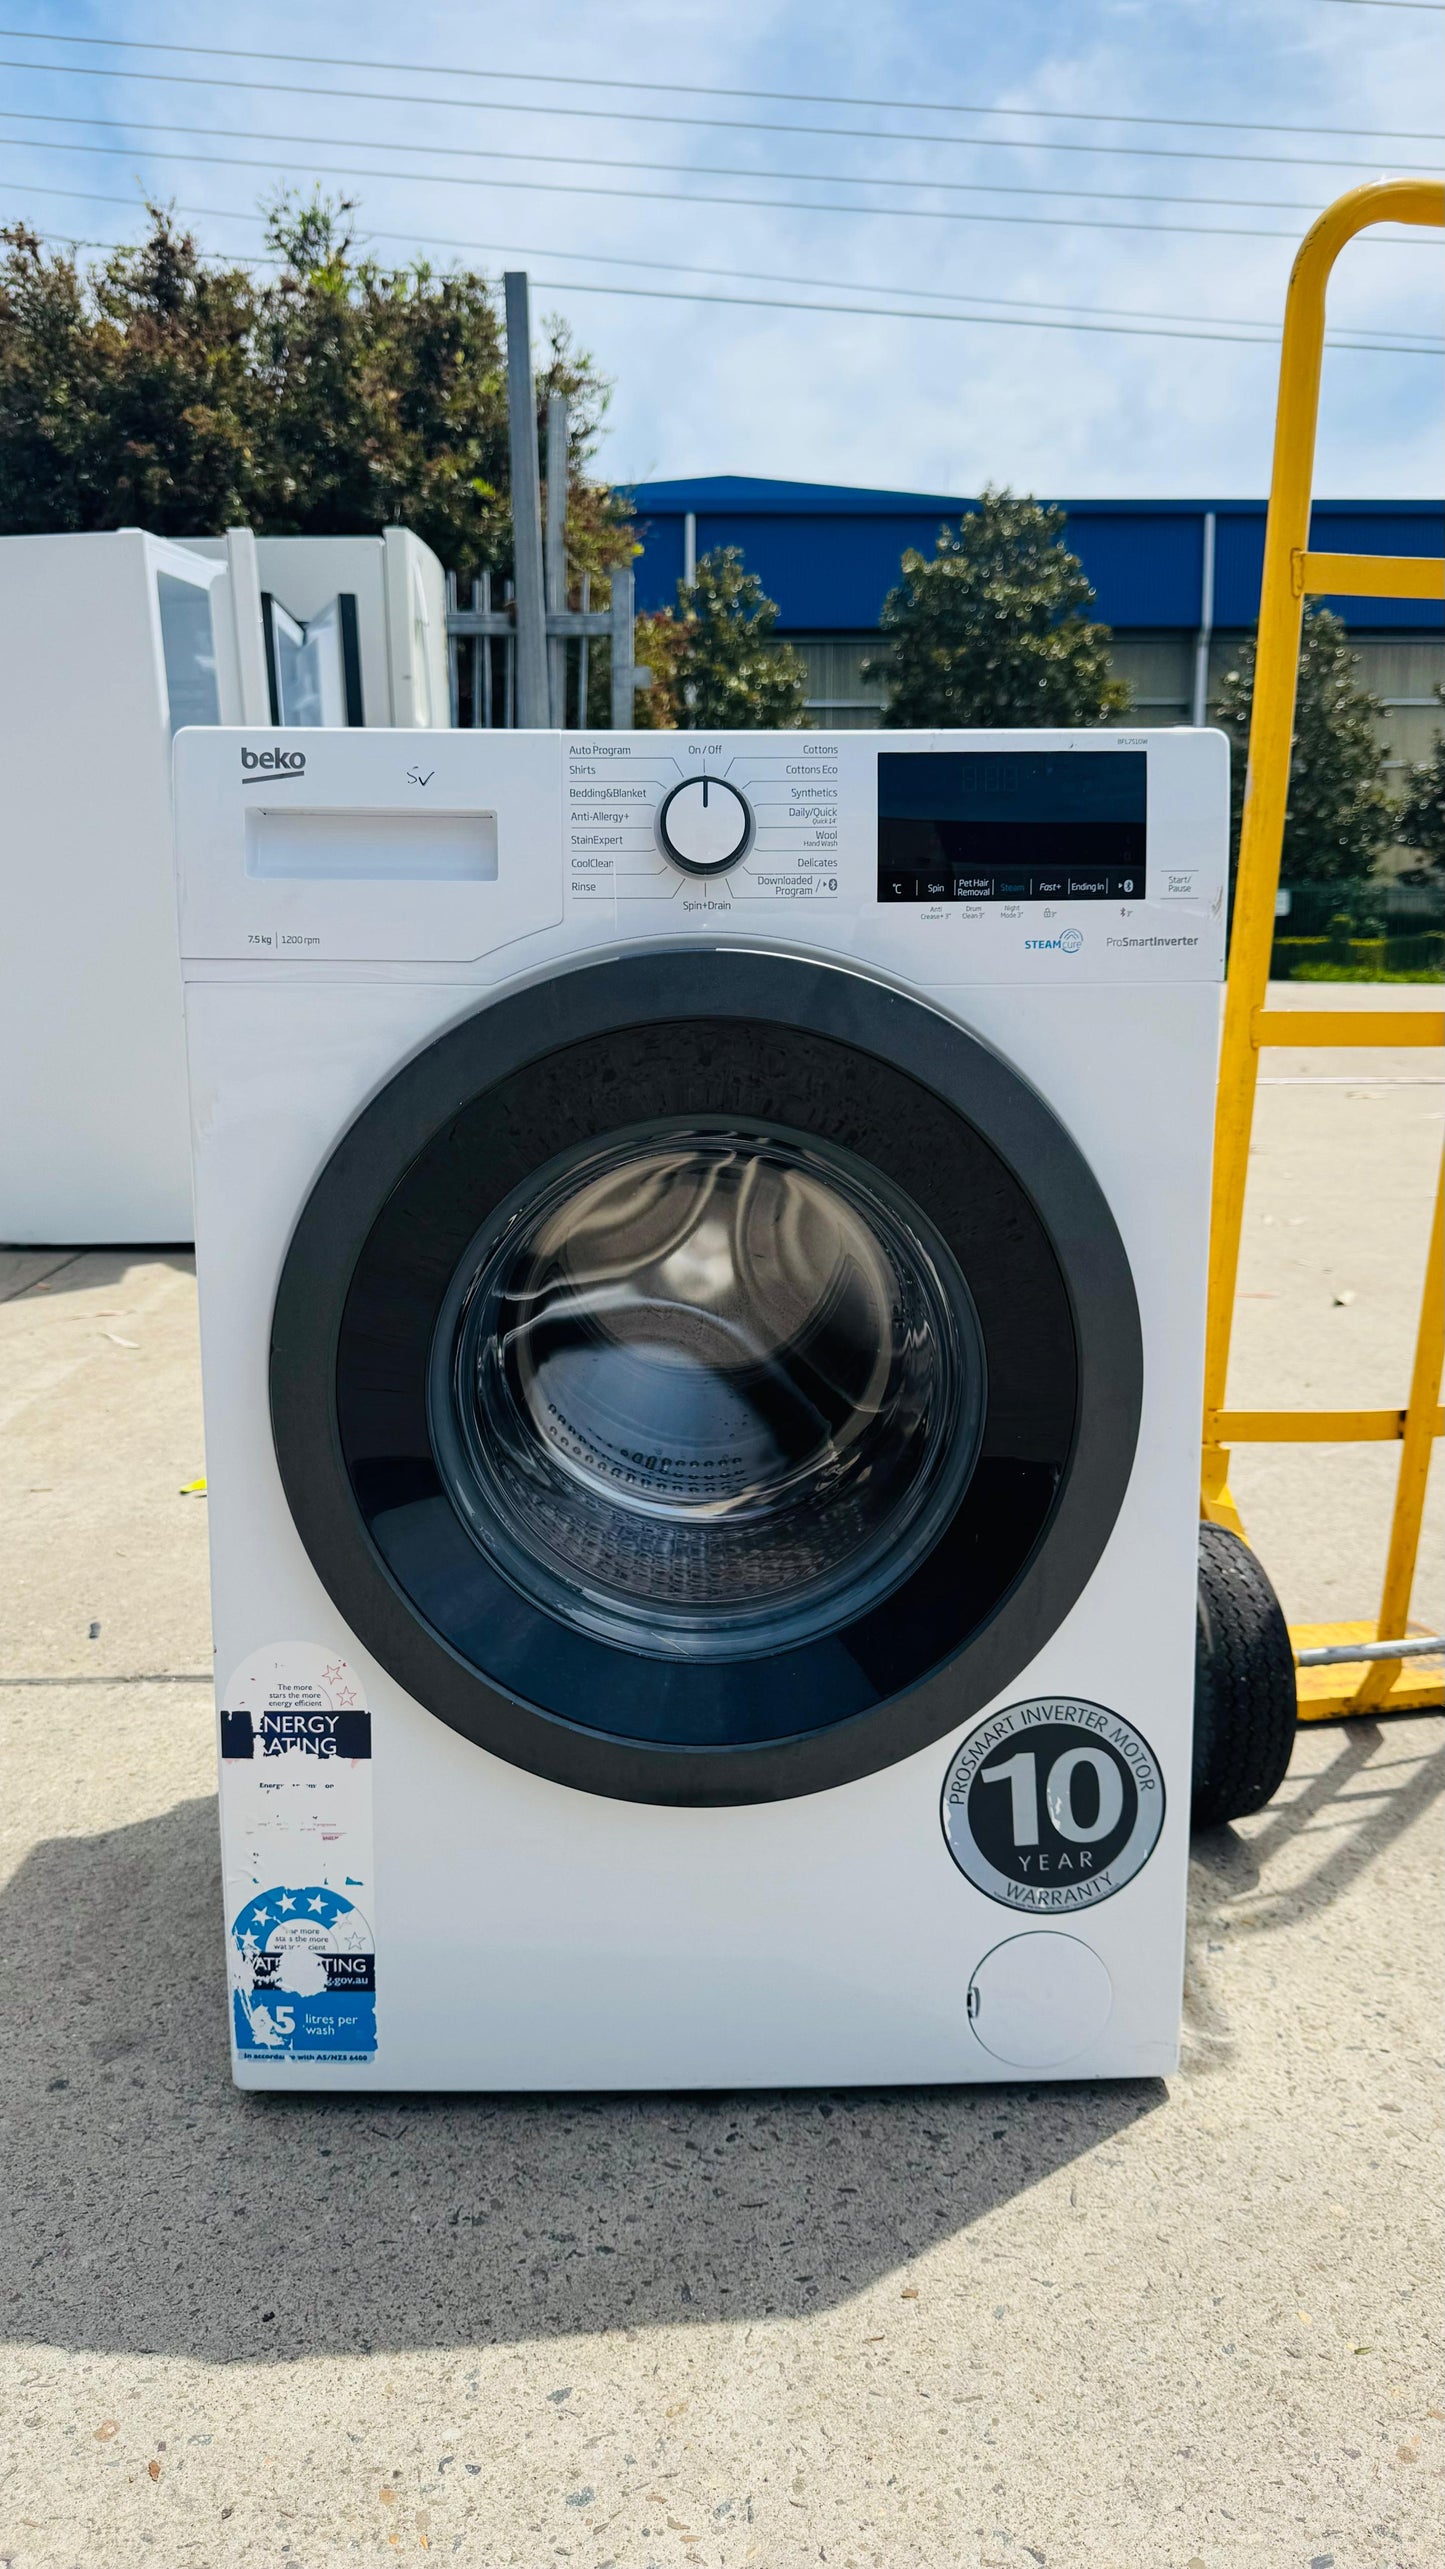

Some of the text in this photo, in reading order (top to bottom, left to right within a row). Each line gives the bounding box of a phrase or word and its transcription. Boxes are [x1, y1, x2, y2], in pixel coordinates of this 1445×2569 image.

[569, 746, 631, 757] Auto Program
[688, 746, 701, 754] On
[708, 745, 722, 754] Off
[803, 745, 839, 754] Cottons
[241, 747, 306, 769] beko
[569, 766, 596, 774] Shirts
[786, 765, 838, 774] Cottons Eco
[569, 789, 647, 800] Bedding&Blanket
[791, 788, 838, 799] Synthetics
[571, 812, 630, 823] Anti-Allergy+
[789, 808, 838, 818] Daily/Quick
[816, 831, 838, 840] Wool
[571, 836, 623, 846] StainExpert
[797, 858, 838, 868] Delicates
[757, 876, 813, 885] Downloaded
[958, 879, 989, 887] Pet Hair
[1168, 876, 1191, 884] Start/
[572, 882, 596, 891] Rinse
[775, 886, 813, 896] Program
[928, 884, 944, 894] Spin
[1001, 884, 1025, 892] Steam
[1039, 883, 1062, 892] Fast+
[1071, 882, 1105, 893] Ending In
[958, 888, 990, 897] Removal
[683, 901, 731, 912] Spin+Drain
[248, 935, 272, 945] 7.5 kg
[281, 936, 320, 946] 1200 rpm
[1106, 937, 1198, 947] ProSmartInverter
[262, 1737, 337, 1754] ATING
[950, 1705, 1156, 1805] PROSMART INVERTER MOTOR
[980, 1747, 1124, 1847] 10
[1019, 1851, 1093, 1872] YEAR
[1006, 1872, 1114, 1905] WARRANTY
[305, 2014, 358, 2027] litres per
[306, 2026, 335, 2035] wash
